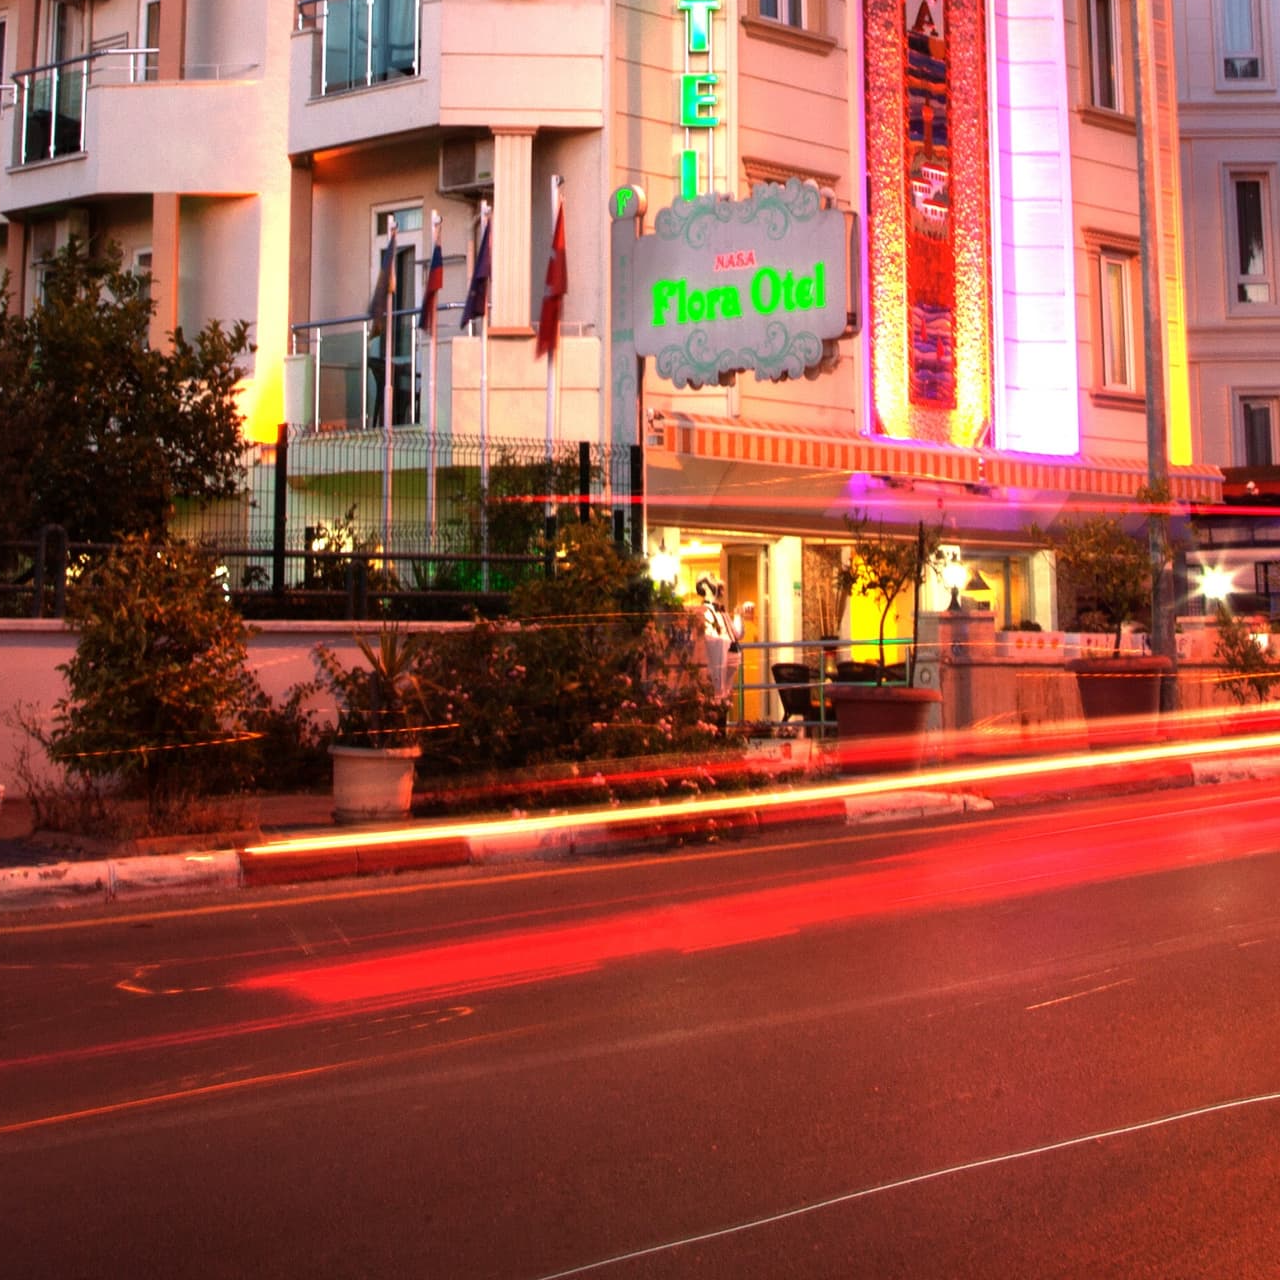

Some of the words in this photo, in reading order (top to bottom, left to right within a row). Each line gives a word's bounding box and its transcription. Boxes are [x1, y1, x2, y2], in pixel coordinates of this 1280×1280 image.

[715, 250, 756, 270] NASA
[651, 277, 742, 326] Flora
[751, 261, 825, 314] Otel
